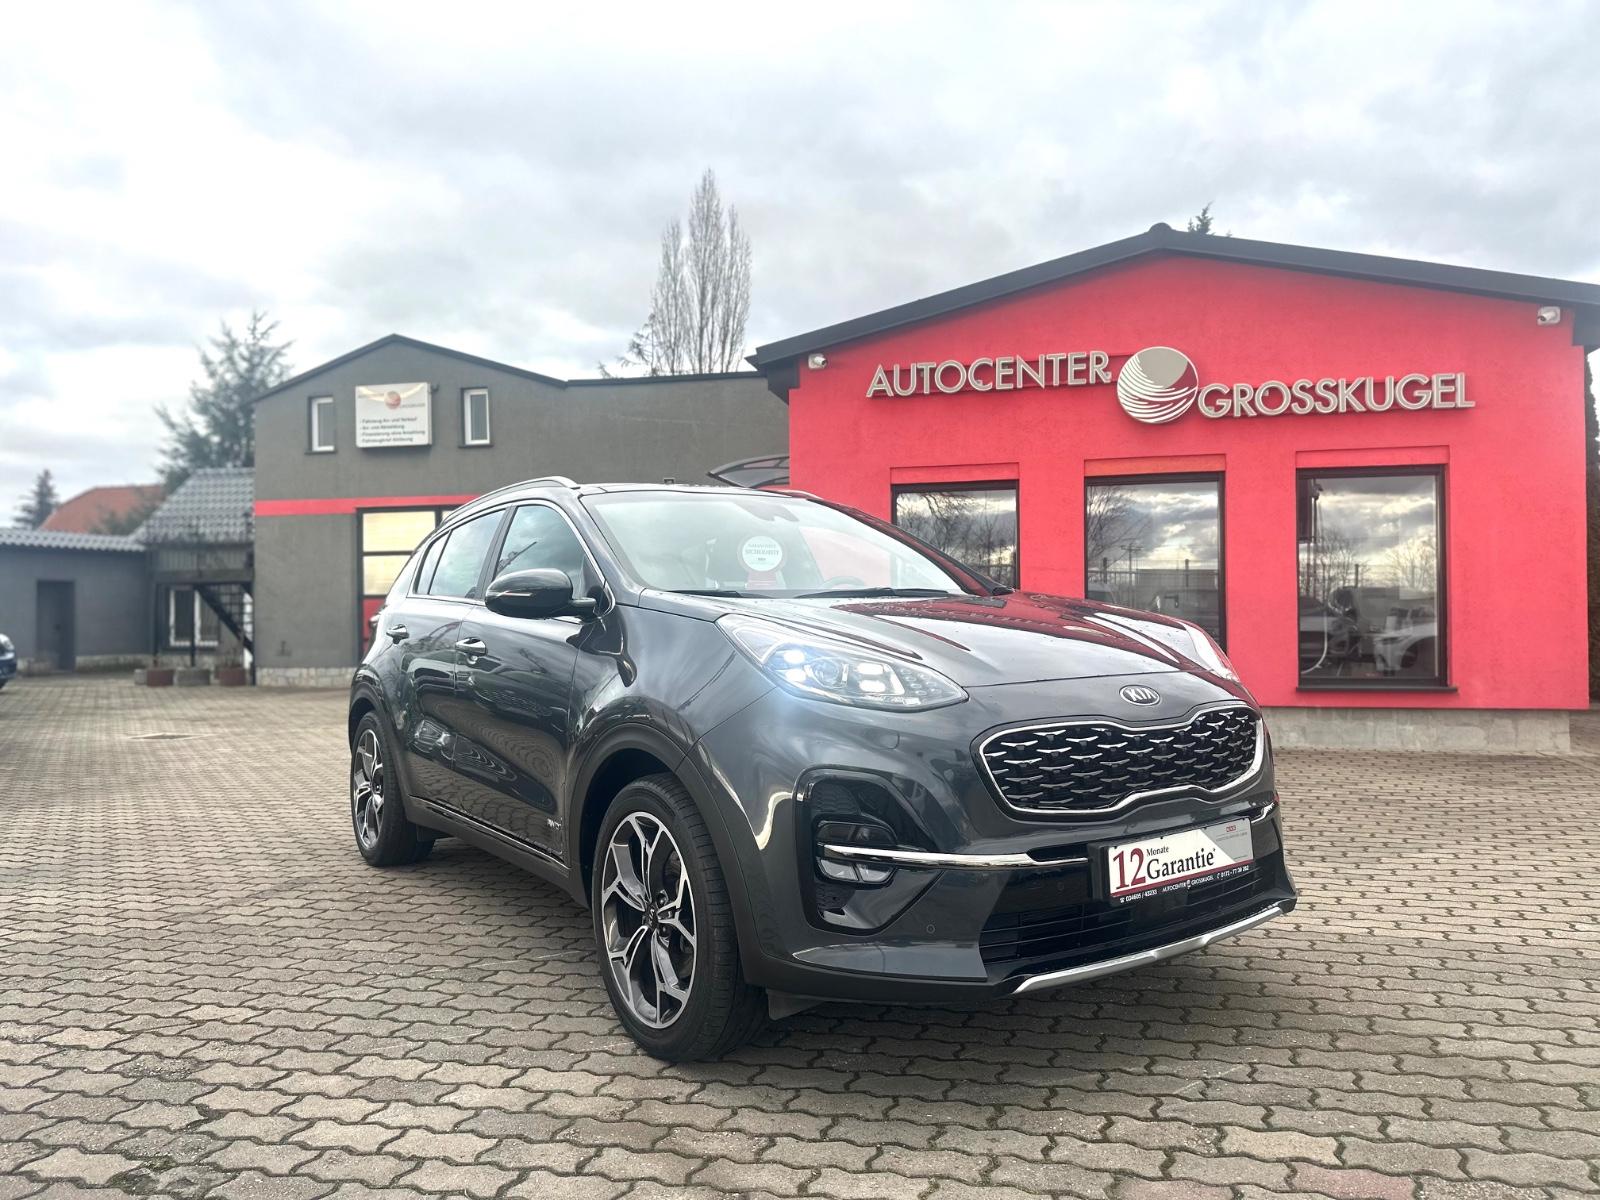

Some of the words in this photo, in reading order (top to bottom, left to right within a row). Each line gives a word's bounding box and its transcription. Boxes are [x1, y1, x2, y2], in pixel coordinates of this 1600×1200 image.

[865, 350, 1113, 399] AUTOCENTER
[1197, 372, 1477, 418] GROSSKUGEL
[1125, 687, 1157, 702] KIA
[1146, 845, 1169, 857] Monate
[1112, 847, 1147, 890] 12
